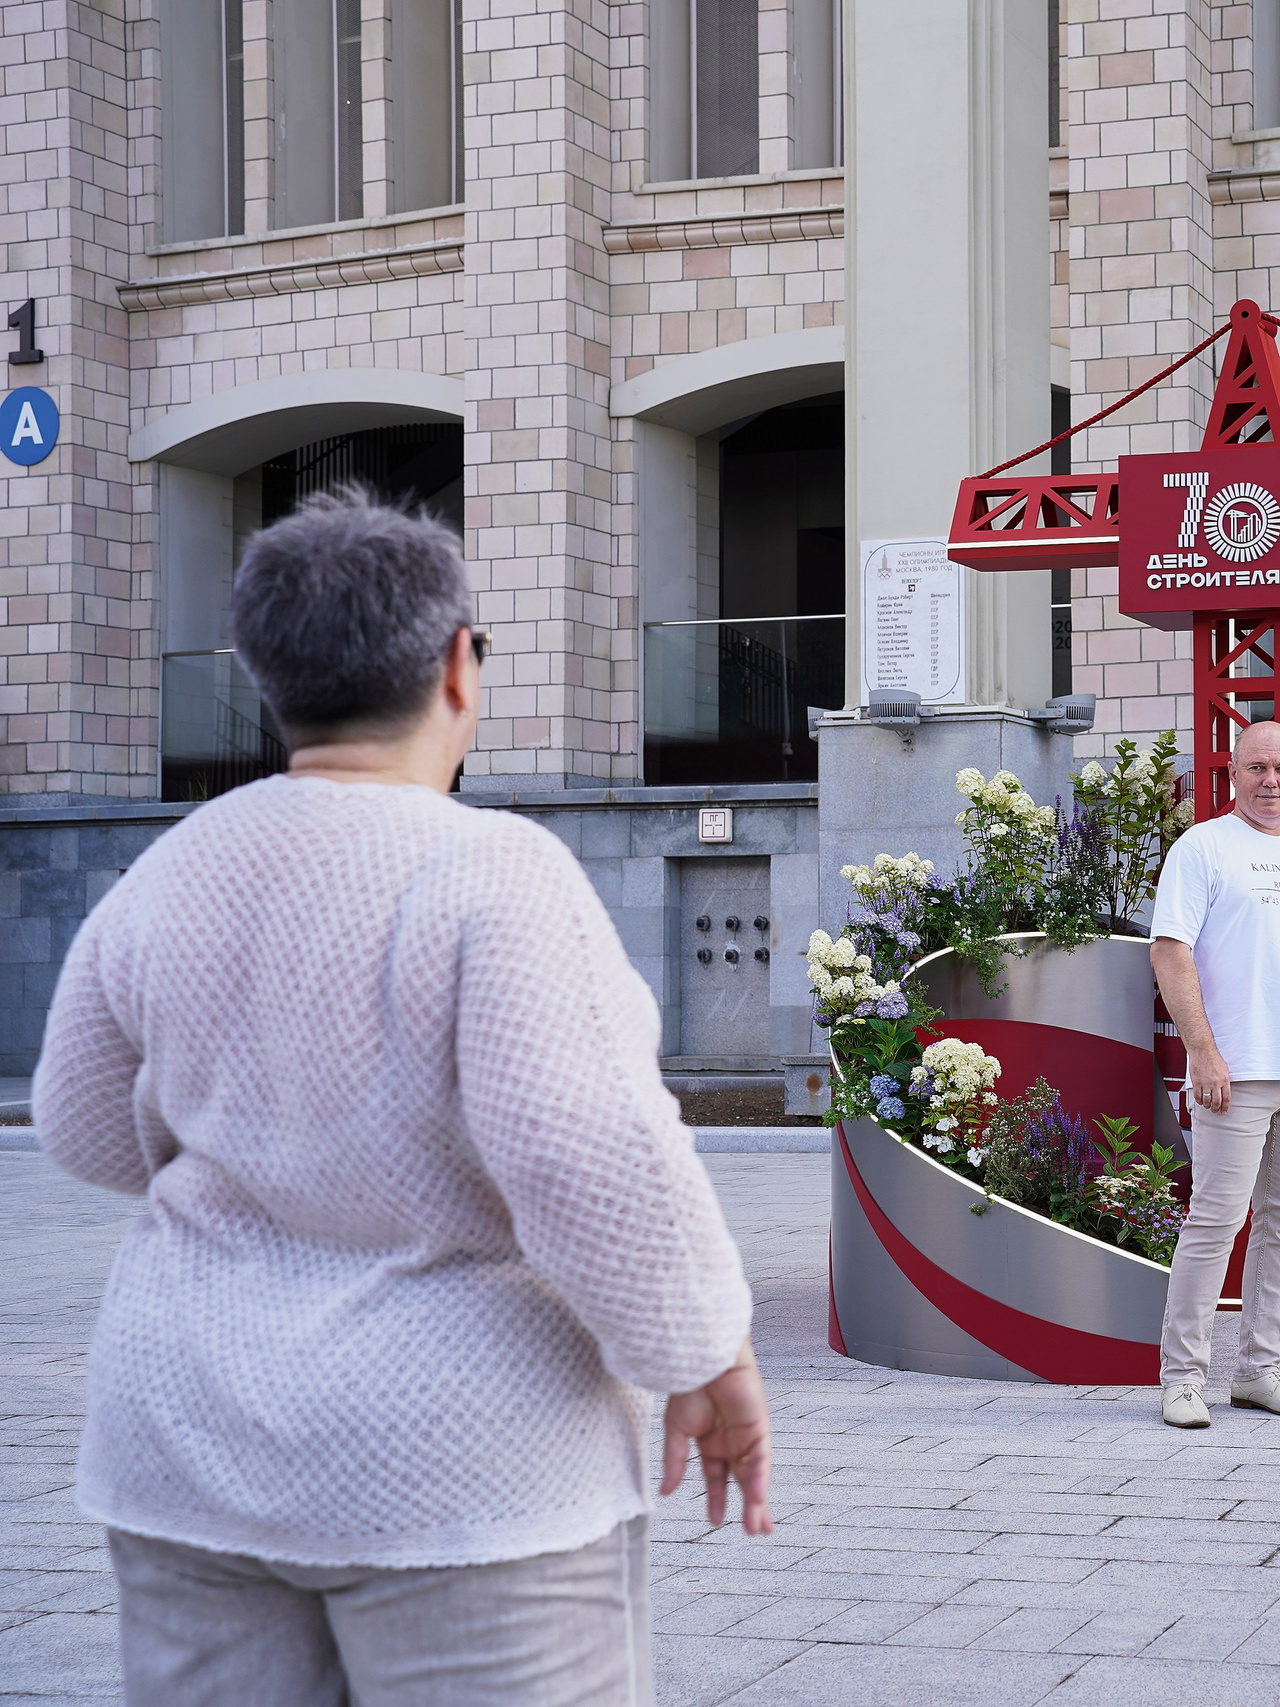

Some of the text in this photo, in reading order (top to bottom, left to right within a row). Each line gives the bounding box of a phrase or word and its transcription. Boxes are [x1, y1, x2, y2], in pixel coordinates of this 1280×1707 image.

[9, 298, 43, 365] 1
[1146, 553, 1208, 569] ДЕНЬ
[1146, 569, 1280, 590] СТРОИТЕЛЯ
